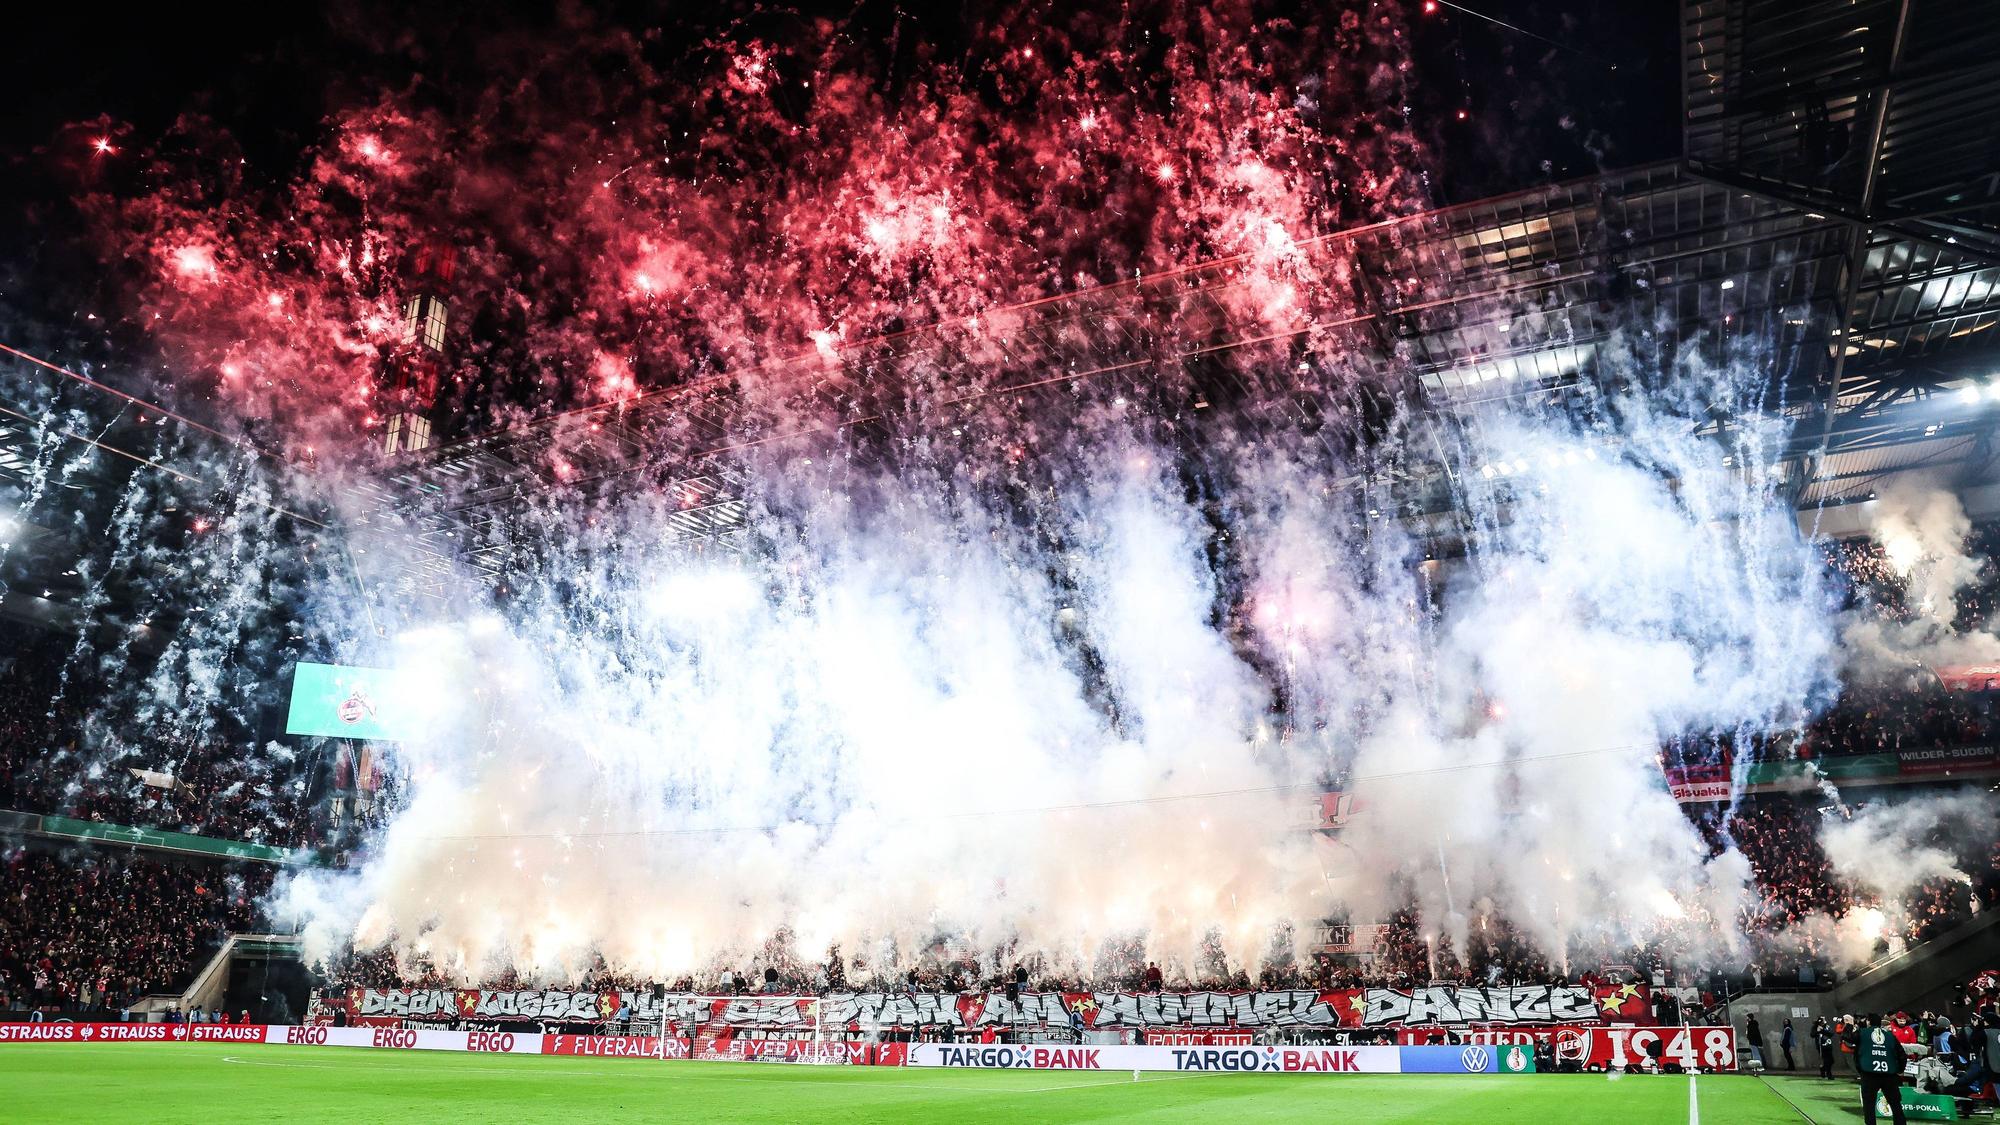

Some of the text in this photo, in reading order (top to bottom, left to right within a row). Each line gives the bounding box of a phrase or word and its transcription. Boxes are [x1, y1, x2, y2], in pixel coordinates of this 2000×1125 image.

[1673, 787, 1728, 799] Slovakia
[474, 990, 601, 1019] LOSSE
[977, 992, 1070, 1025] AM
[1093, 991, 1337, 1026] HIMMEL
[1363, 986, 1600, 1024] DANZE
[100, 1025, 166, 1039] STRAUSS
[194, 1026, 261, 1040] STRAUSS
[287, 1026, 514, 1052] ERGO ERGO ERGO
[574, 1036, 691, 1058] FLYERALARM
[1607, 1029, 1733, 1069] 1948
[1872, 1060, 1889, 1072] 29
